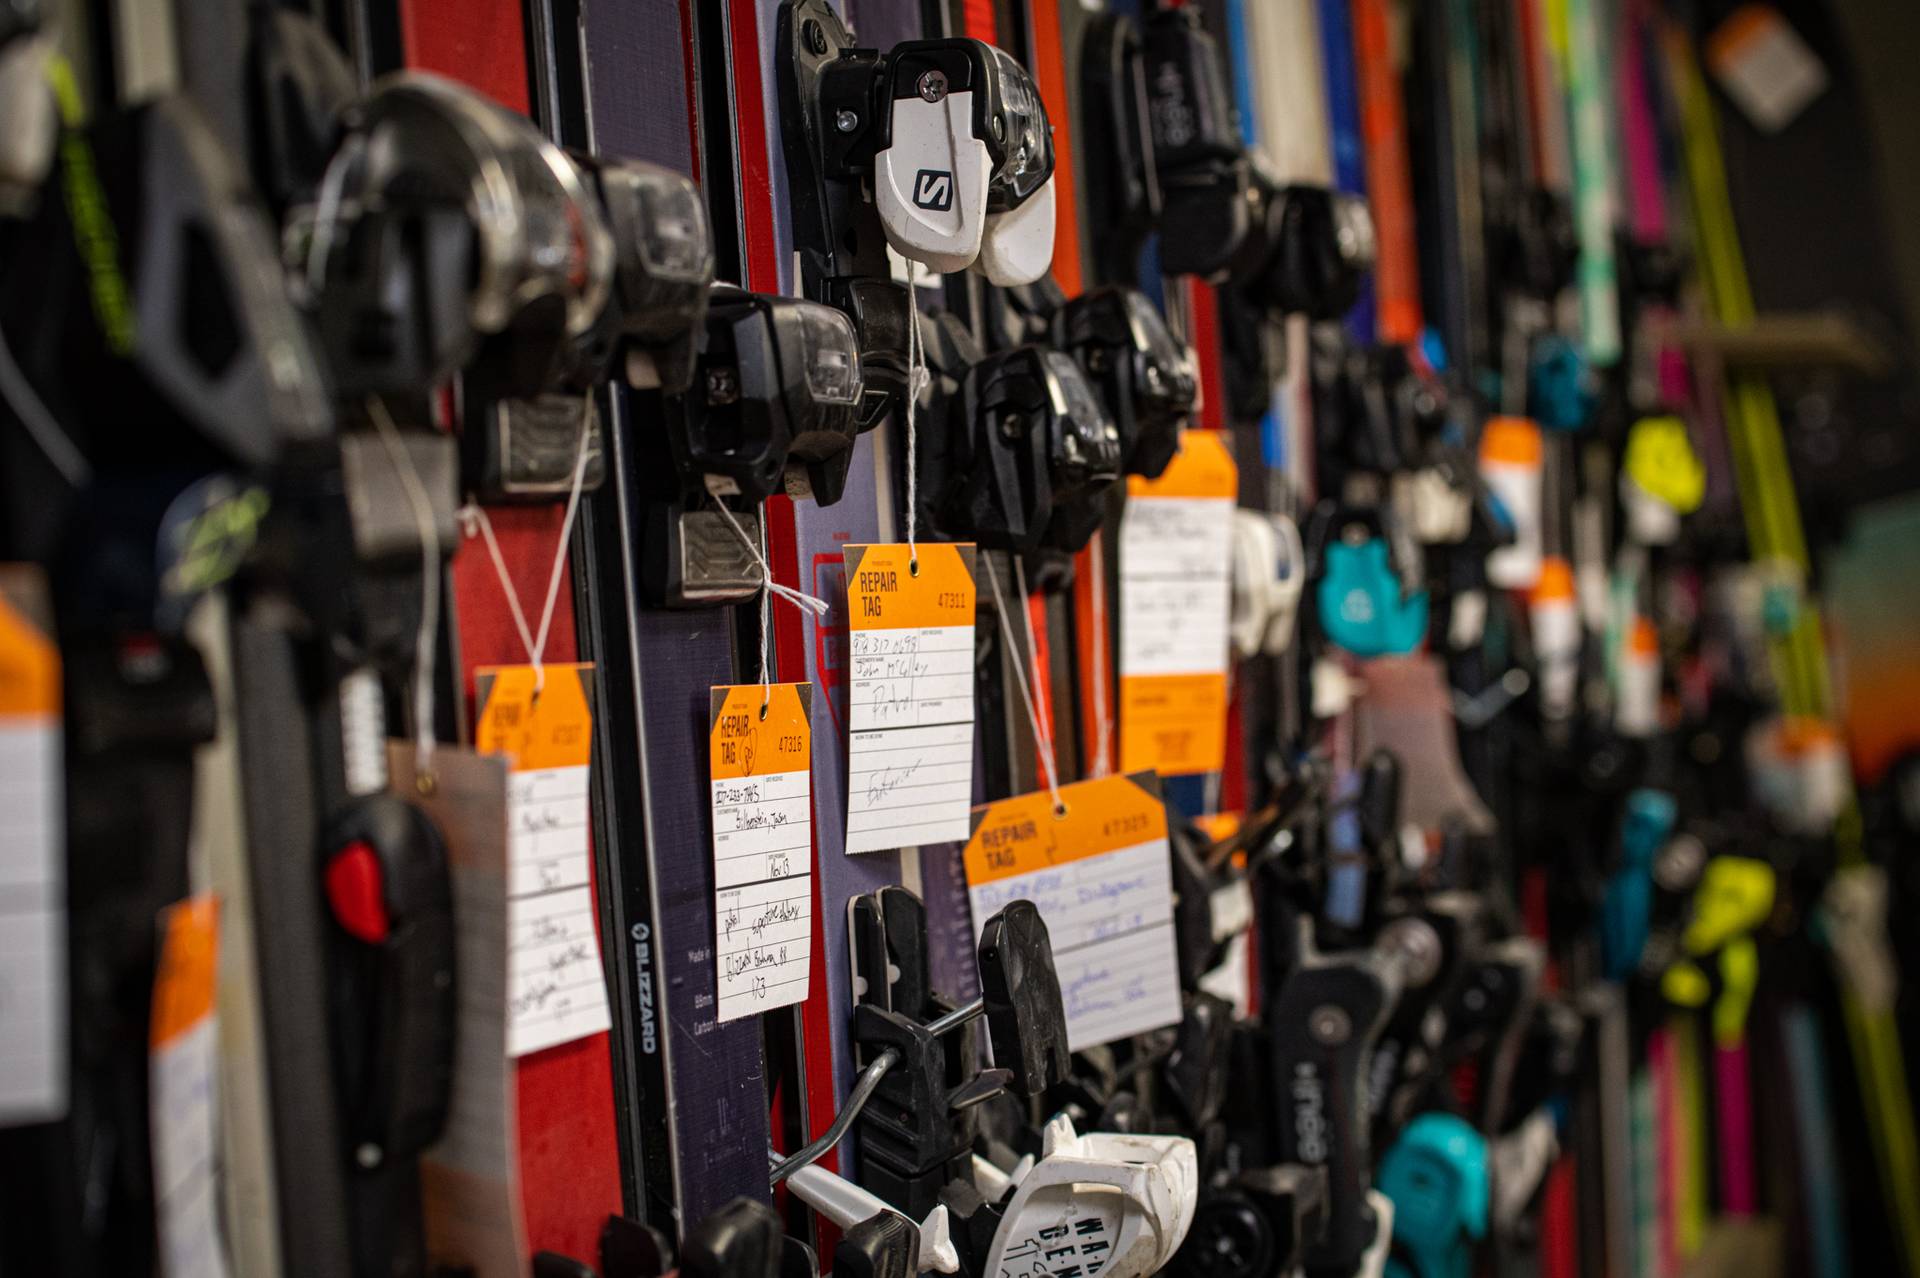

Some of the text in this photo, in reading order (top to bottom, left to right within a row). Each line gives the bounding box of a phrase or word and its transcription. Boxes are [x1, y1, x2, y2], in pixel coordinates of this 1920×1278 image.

[860, 571, 898, 593] REPAIR
[861, 596, 882, 617] TAG
[937, 592, 966, 609] 47311
[721, 714, 750, 738] REPAIR
[721, 741, 736, 765] TAG
[778, 736, 803, 753] 47316
[981, 820, 1039, 850] REPAIR
[986, 847, 1016, 872] TAG
[635, 942, 656, 1054] BLIZZARD
